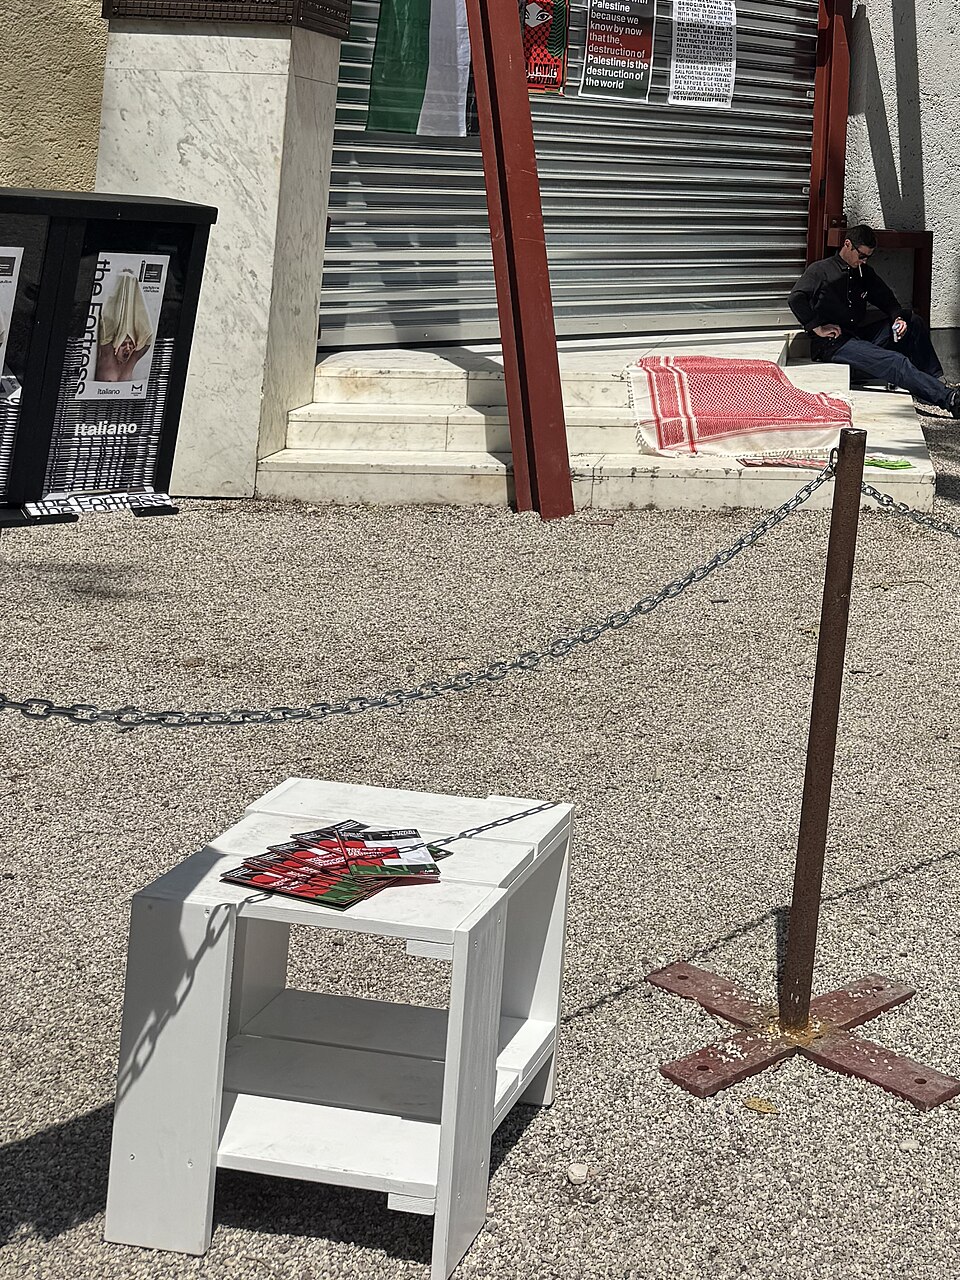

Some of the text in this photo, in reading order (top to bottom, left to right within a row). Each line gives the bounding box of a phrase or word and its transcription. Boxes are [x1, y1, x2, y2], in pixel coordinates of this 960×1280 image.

[591, 9, 639, 25] because we
[590, 20, 642, 36] know by now
[590, 32, 620, 44] that the
[588, 44, 646, 59] destruction of
[588, 54, 649, 71] Palestine is the
[586, 66, 644, 81] destruction of
[586, 77, 624, 90] the world
[75, 259, 110, 396] the Fortress
[74, 420, 138, 436] Italiano
